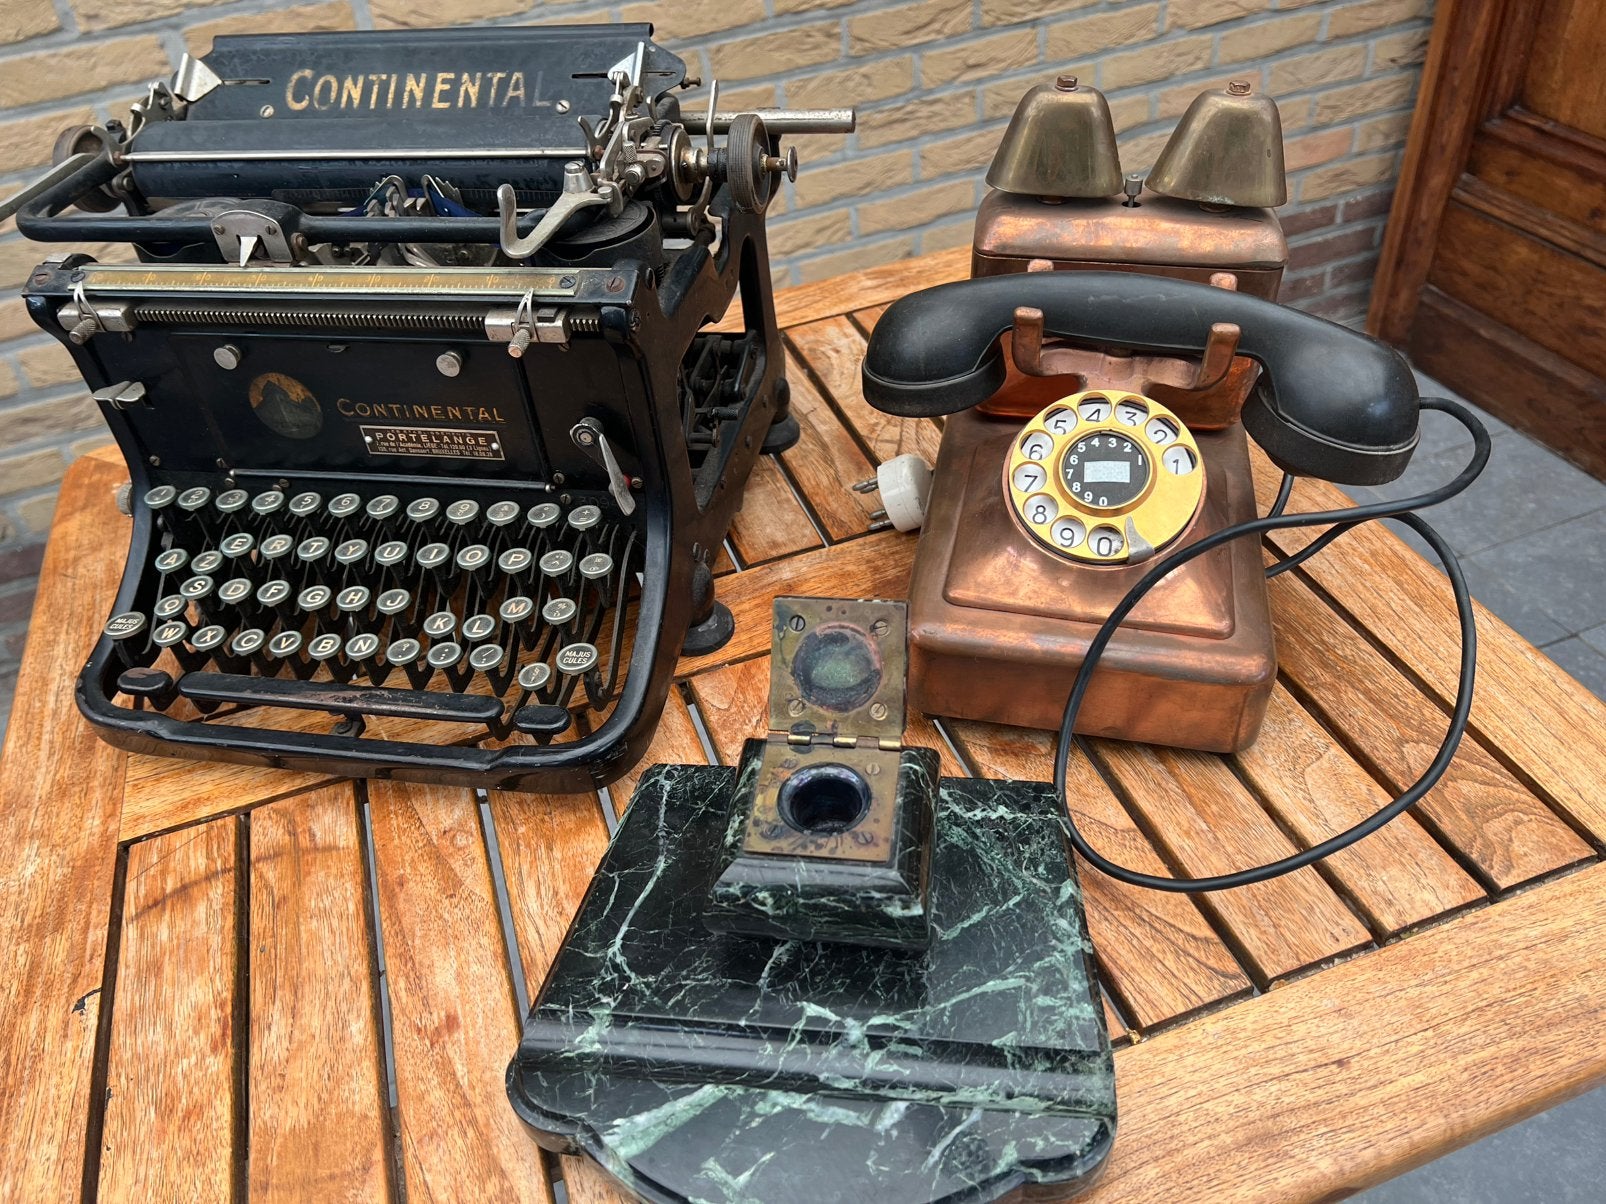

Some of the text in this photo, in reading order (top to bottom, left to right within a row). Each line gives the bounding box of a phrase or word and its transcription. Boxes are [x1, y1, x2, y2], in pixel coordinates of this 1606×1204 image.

[285, 68, 553, 111] CONTINENTAL
[337, 398, 505, 421] CONTINENTAL
[1086, 408, 1101, 422] 4
[1125, 411, 1137, 427] 3
[1053, 419, 1067, 435] 5
[375, 432, 487, 445] PORTELANGE
[1091, 437, 1100, 447] 4
[1153, 429, 1168, 444] 2
[1077, 442, 1086, 452] 5
[1108, 438, 1117, 448] 3
[1123, 442, 1132, 453] 2
[1029, 444, 1043, 460] 6
[1070, 455, 1079, 465] 6
[1172, 459, 1180, 475] 1
[1065, 469, 1074, 480] 7
[1023, 475, 1038, 492] 7
[1072, 482, 1081, 492] 8
[1084, 491, 1093, 502] 9
[1099, 496, 1108, 507] 0
[1032, 505, 1047, 525] 8
[1060, 527, 1075, 548] 9
[231, 538, 247, 549] E
[270, 540, 286, 550] R
[308, 542, 322, 553] T
[1096, 536, 1112, 557] 0
[346, 545, 358, 555] Y
[383, 547, 400, 557] U
[164, 553, 178, 564] A
[200, 556, 215, 567] Z
[465, 551, 481, 561] O
[508, 554, 523, 564] P
[189, 581, 204, 592] S
[226, 584, 244, 595] D
[267, 585, 283, 597] F
[307, 590, 324, 602] G
[346, 592, 363, 603] H
[387, 595, 402, 606] J
[165, 599, 179, 612] Q
[507, 603, 525, 613] M
[433, 617, 448, 629] K
[472, 620, 484, 632] L
[161, 627, 180, 639] W
[200, 630, 217, 642] X
[240, 634, 258, 647] C
[280, 637, 295, 649] V
[317, 639, 333, 650] B
[356, 639, 373, 651] N
